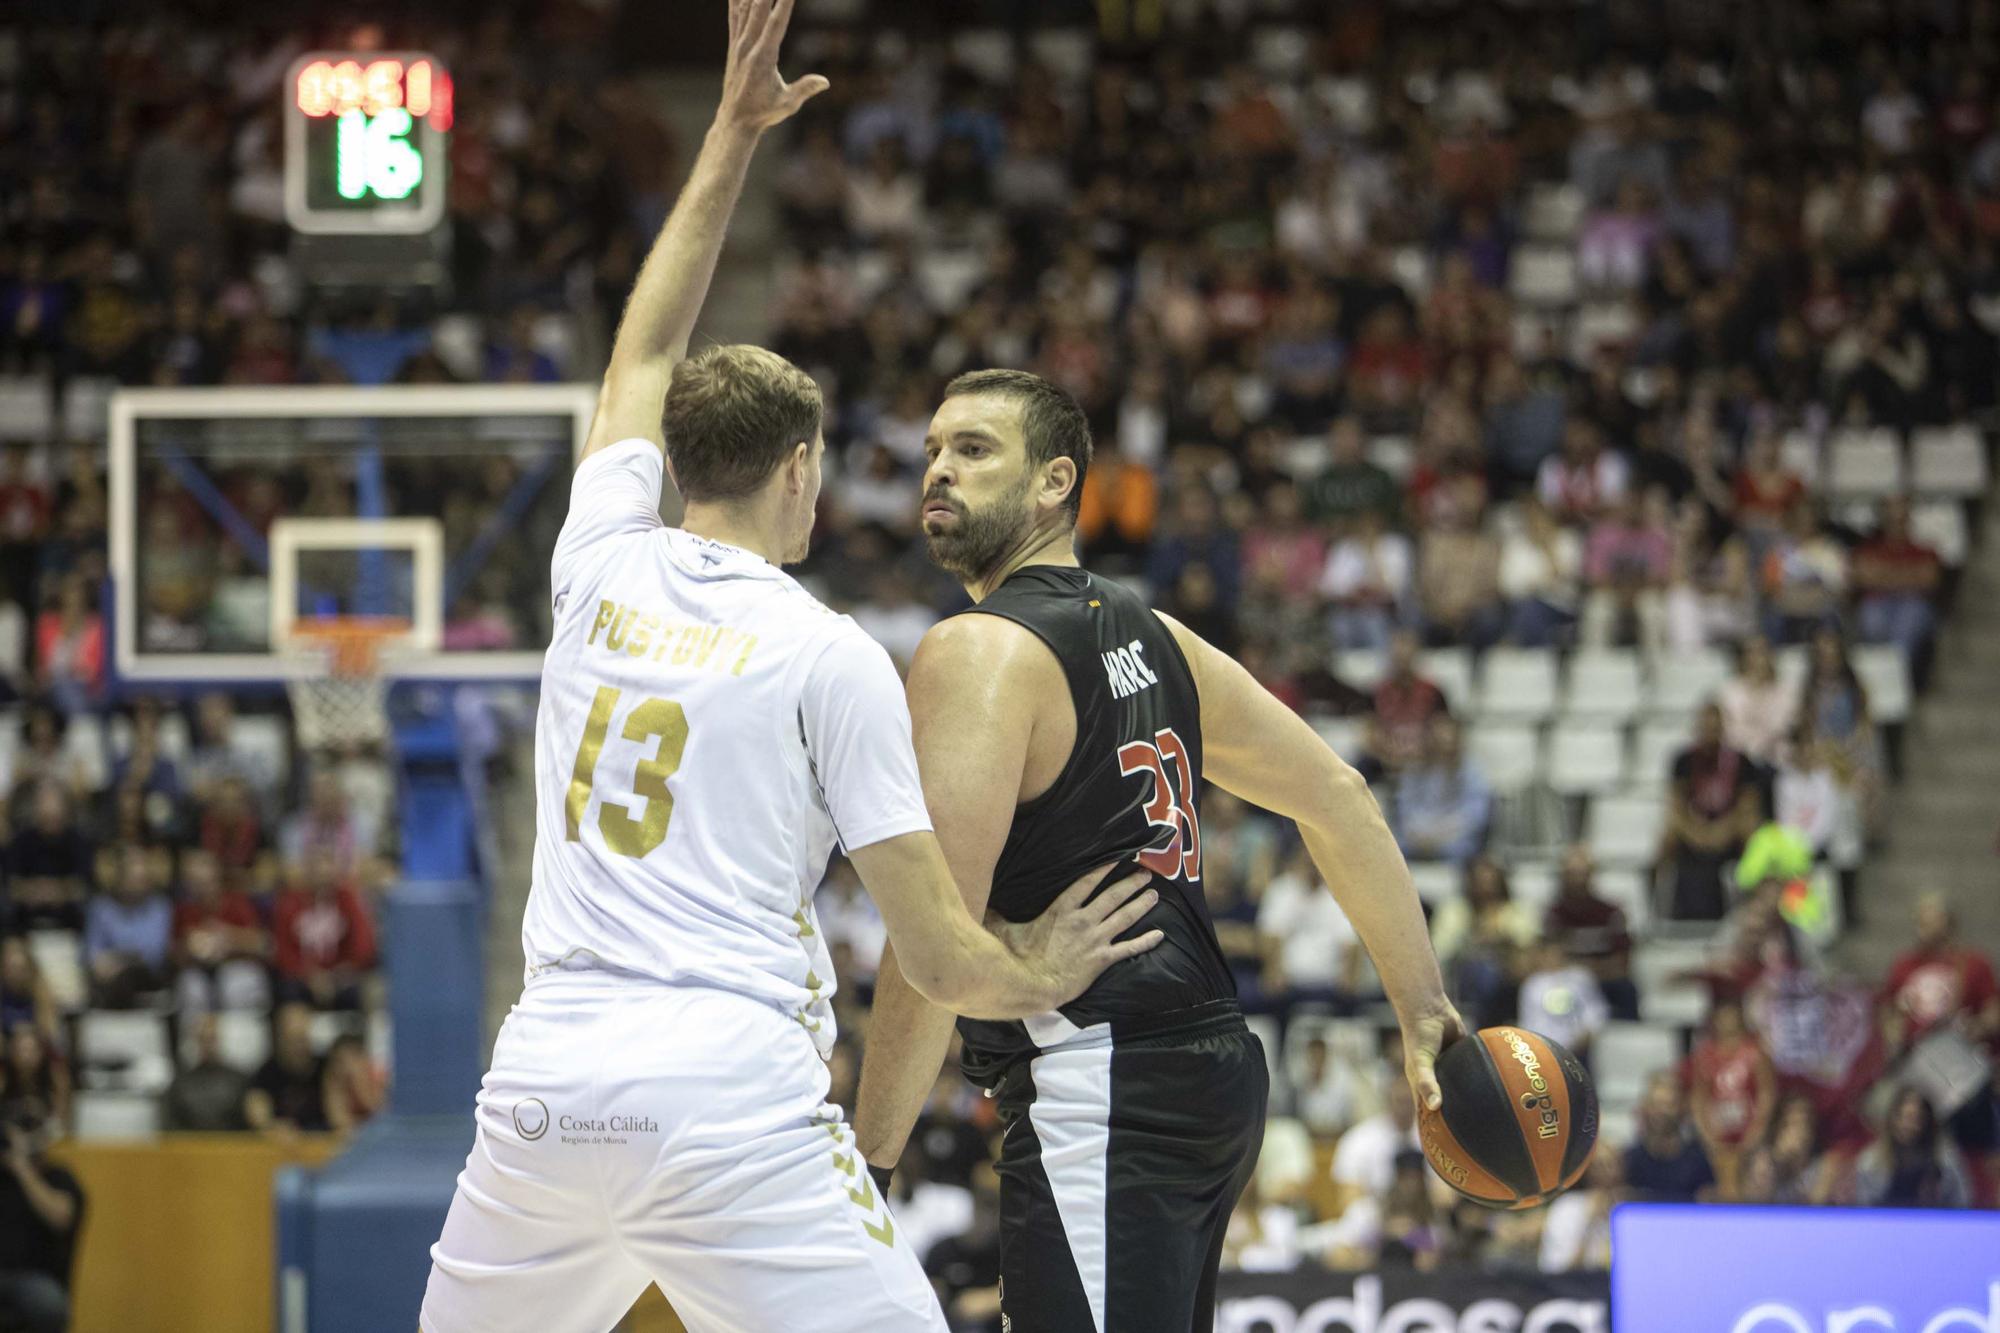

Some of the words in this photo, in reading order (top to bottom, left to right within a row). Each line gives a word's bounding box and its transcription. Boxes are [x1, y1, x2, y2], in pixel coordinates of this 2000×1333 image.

[338, 107, 423, 199] 16
[1100, 639, 1158, 699] MARC
[565, 685, 690, 860] 13
[1117, 727, 1201, 883] 33
[559, 1115, 606, 1131] Costa
[610, 1115, 659, 1132] Cálida
[561, 1135, 590, 1145] Región
[592, 1136, 602, 1144] de
[603, 1135, 627, 1144] Murcia
